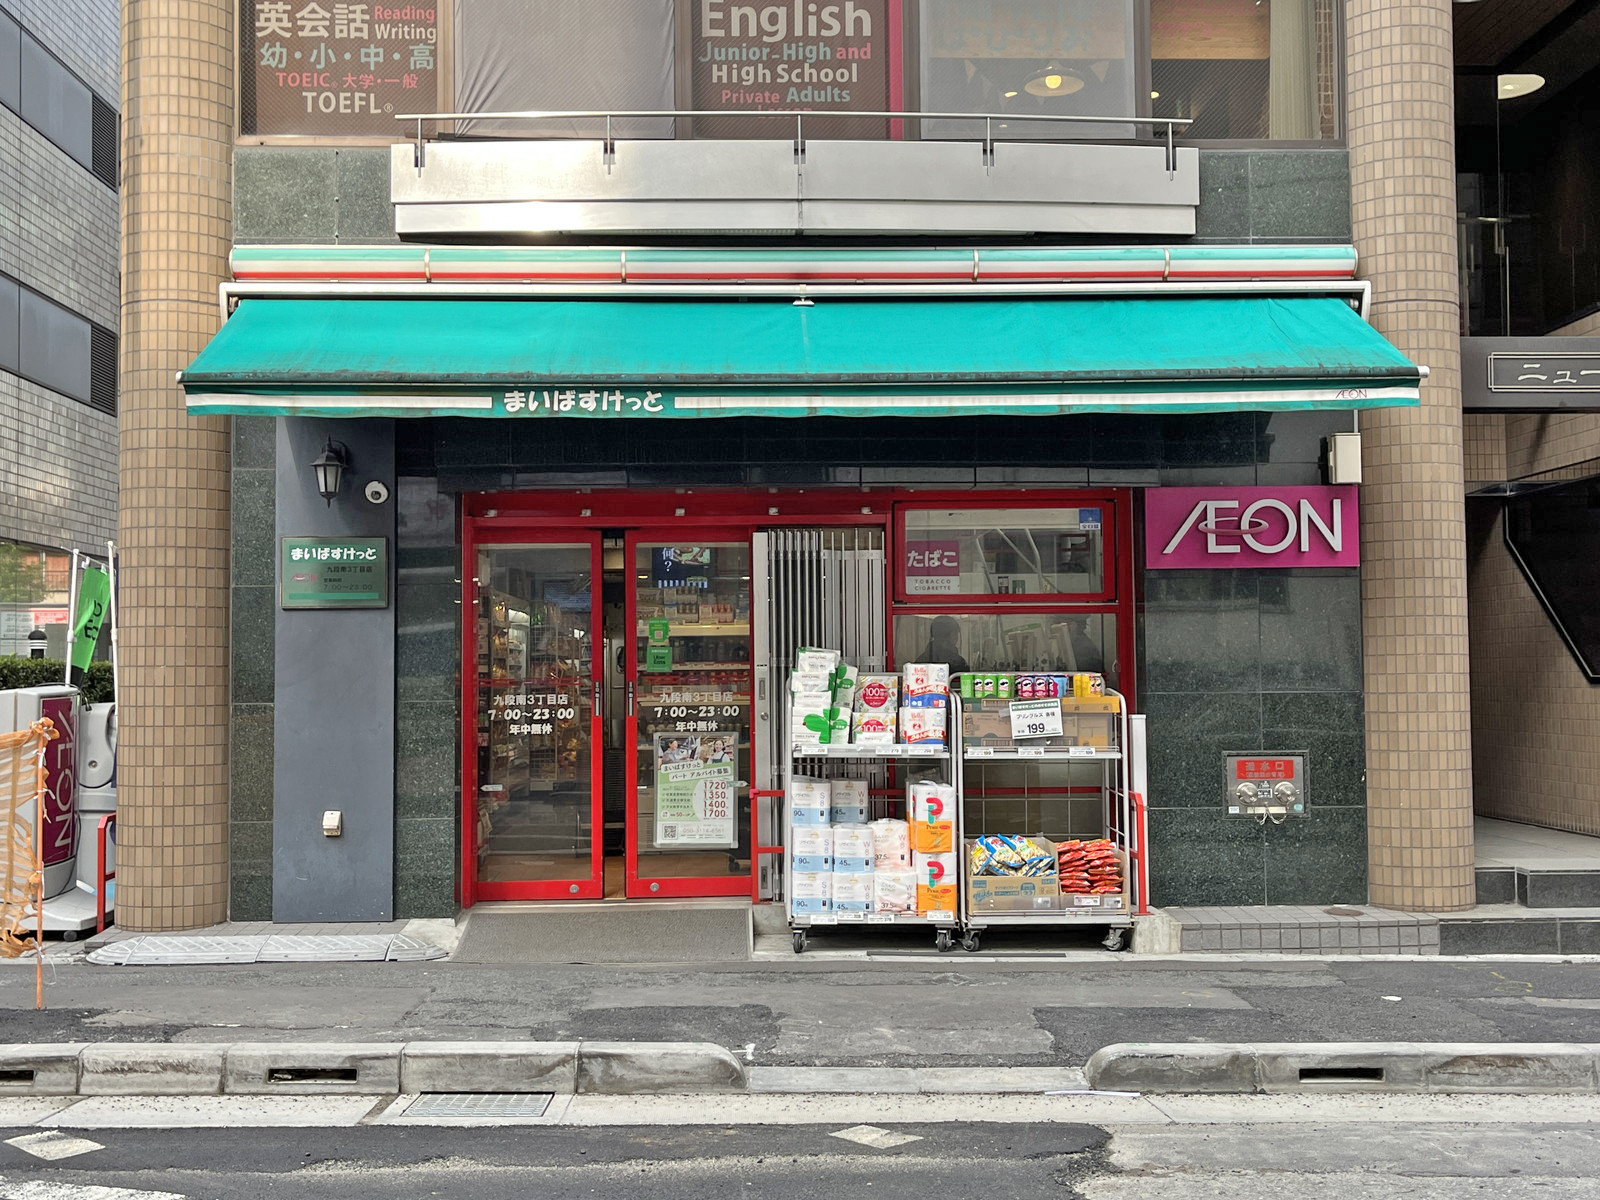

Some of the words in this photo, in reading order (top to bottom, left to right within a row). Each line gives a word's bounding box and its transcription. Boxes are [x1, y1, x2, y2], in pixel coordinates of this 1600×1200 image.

[256, 2, 370, 39] 英会話
[374, 6, 435, 23] Reading
[702, 0, 871, 42] English
[374, 24, 437, 43] Writing
[836, 43, 871, 59] and
[712, 64, 771, 85] High
[776, 63, 858, 83] School
[721, 90, 780, 103] Private
[786, 86, 850, 103] Adults
[1518, 364, 1600, 384] ニュー
[503, 390, 664, 412] まいばすけっと
[291, 547, 377, 560] まいばすけっと
[907, 549, 958, 567] たばこ
[493, 694, 568, 705] 九段南3丁目店
[660, 691, 733, 703] 九段南3丁目店
[865, 688, 880, 696] 100
[509, 723, 553, 735] 年中無休
[675, 720, 718, 732] 年中無休
[1027, 723, 1045, 733] 199
[664, 762, 701, 772] まいばすけっと
